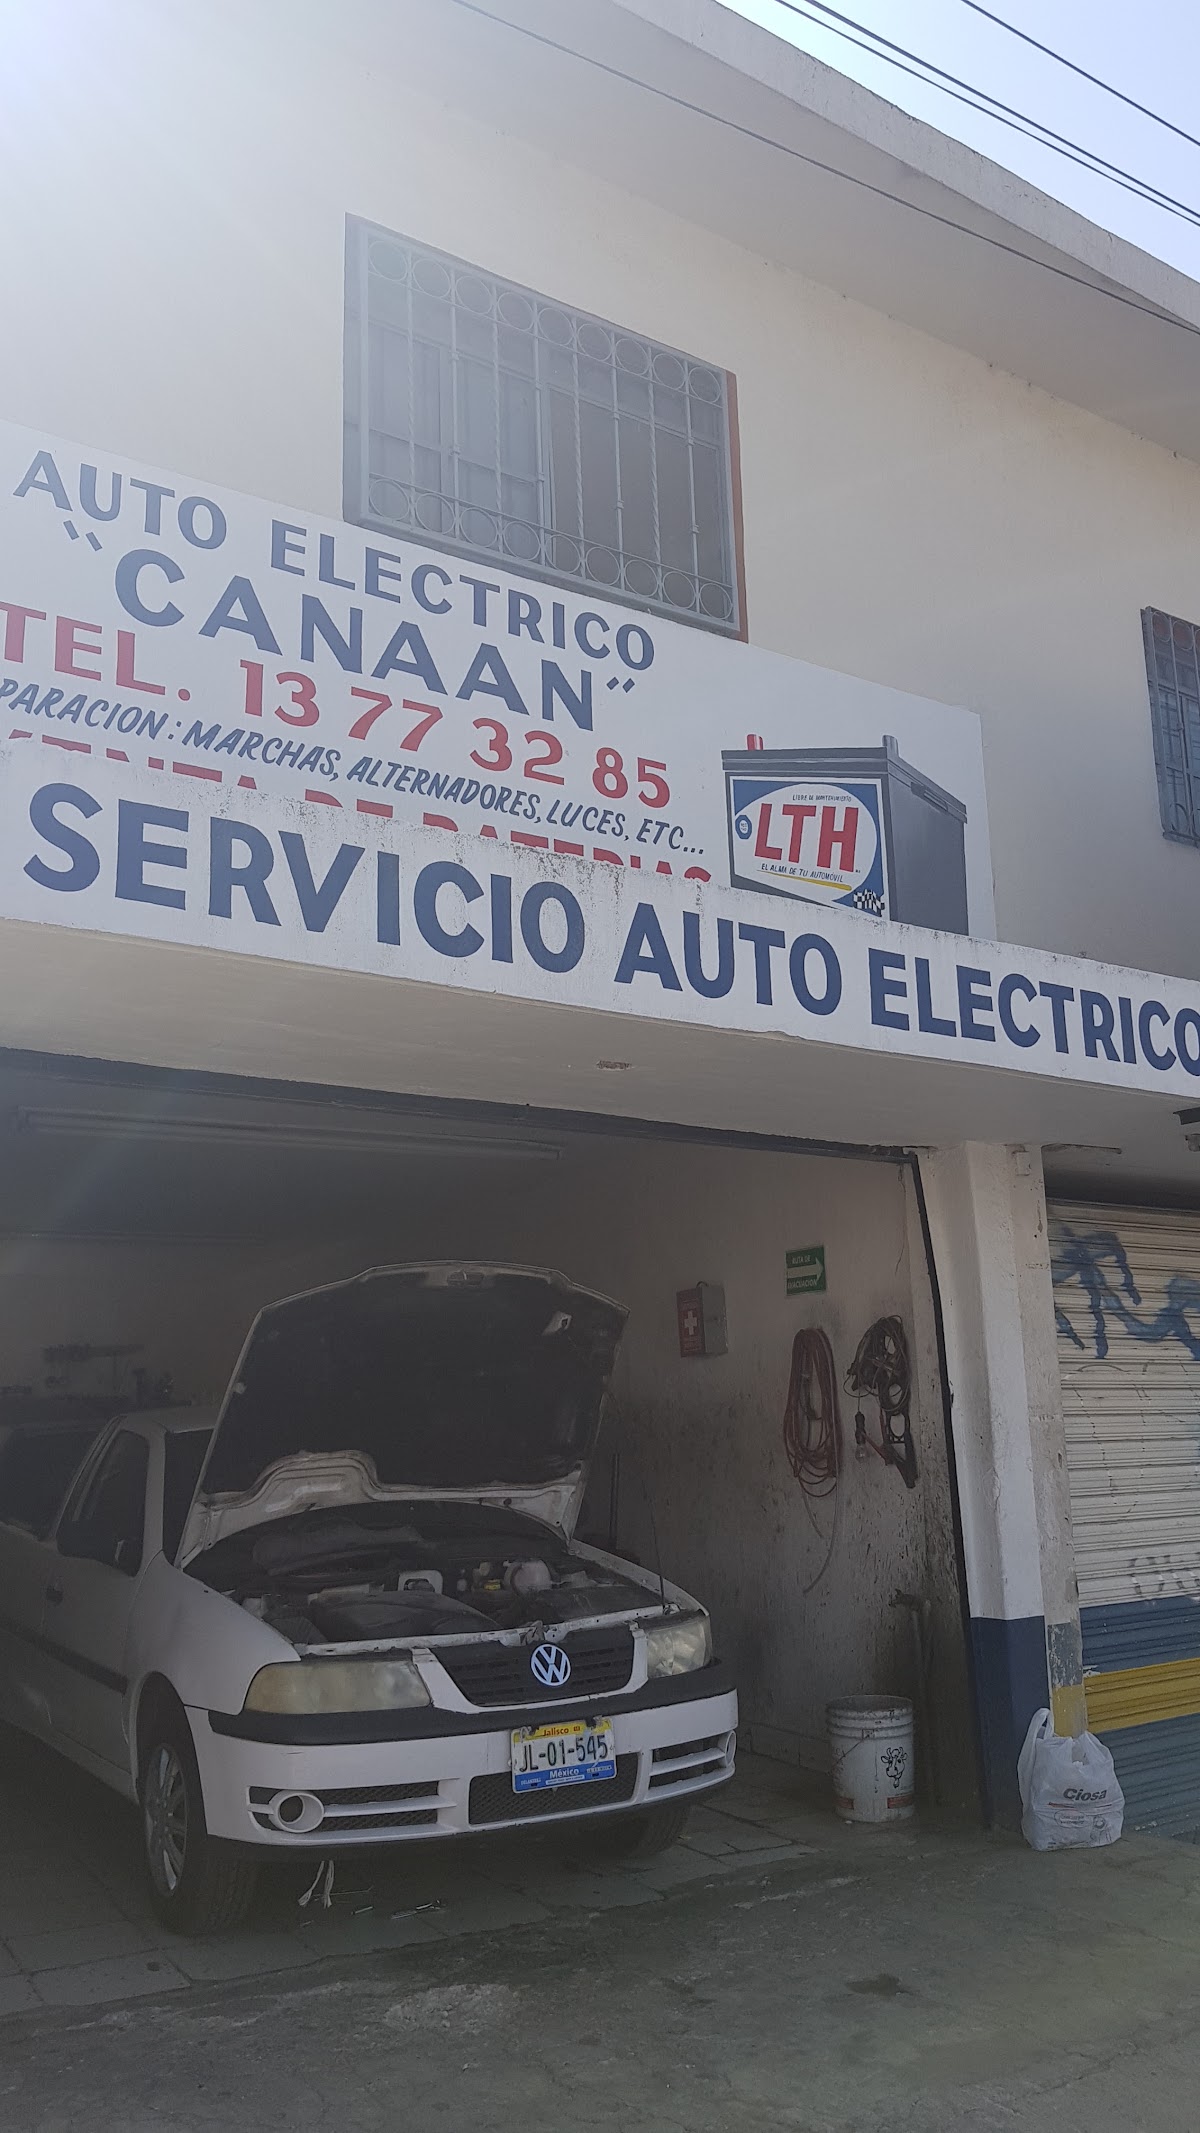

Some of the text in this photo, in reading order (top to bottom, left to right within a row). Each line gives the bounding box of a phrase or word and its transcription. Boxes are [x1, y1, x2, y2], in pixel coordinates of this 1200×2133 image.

[13, 451, 655, 671] AUTO ELECTRICO
[0, 603, 670, 808] TEL. 13 77 32 85
[187, 719, 340, 783] MARCHAS,
[348, 755, 541, 823] ALTERNADORES,
[548, 801, 630, 842] LUCES,
[636, 819, 704, 855] ETC...
[754, 803, 859, 873] LTH
[761, 863, 769, 871] EL
[770, 864, 788, 873] ALMA
[788, 866, 797, 876] DE
[799, 868, 809, 877] TU
[23, 782, 586, 973] SERVICIO
[614, 902, 842, 1017] AUTO
[868, 947, 1200, 1077] ELECTRICO
[543, 1726, 569, 1737] Jalisco
[549, 1767, 580, 1779] México
[1063, 1787, 1107, 1801] Ciosa
